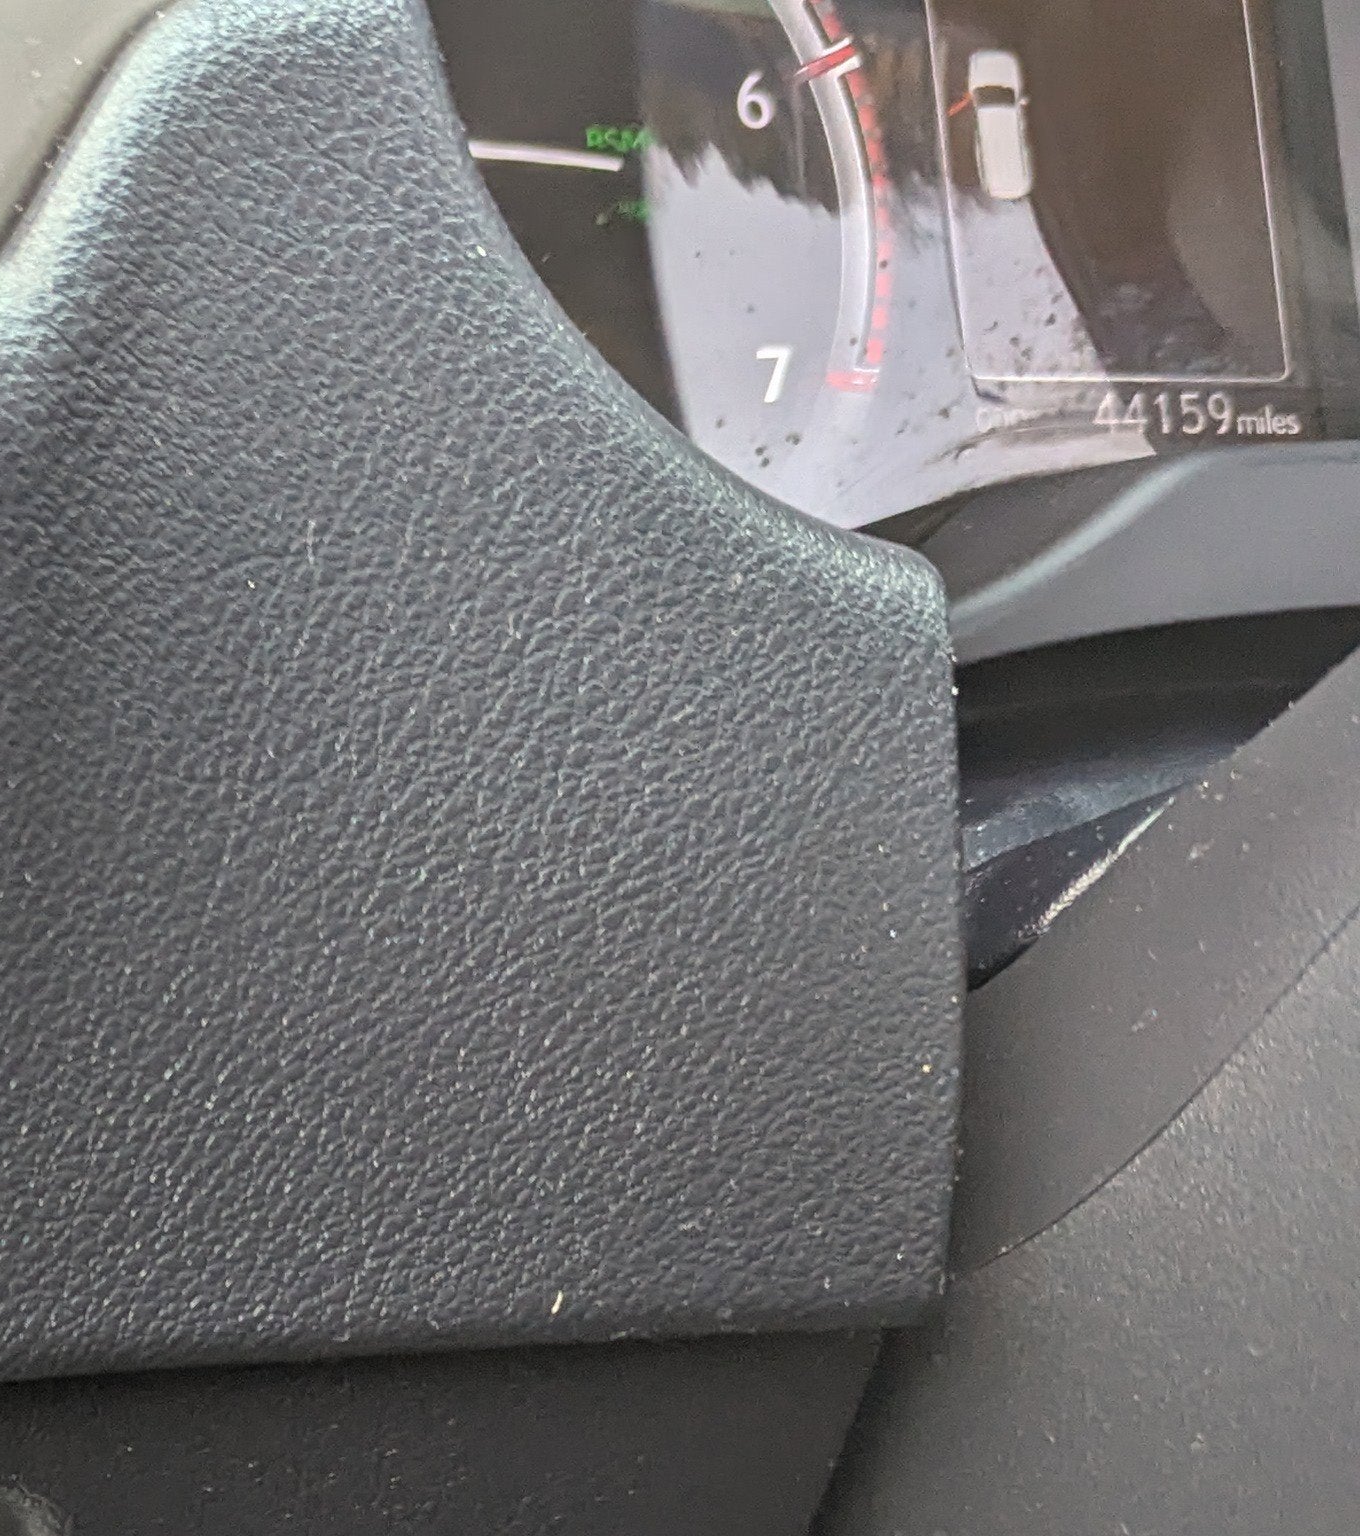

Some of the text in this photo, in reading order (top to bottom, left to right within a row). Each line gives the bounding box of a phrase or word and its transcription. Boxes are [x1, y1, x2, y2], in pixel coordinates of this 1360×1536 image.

[737, 70, 774, 130] 6
[756, 348, 792, 403] 7
[1092, 391, 1301, 435] 44159 miles
